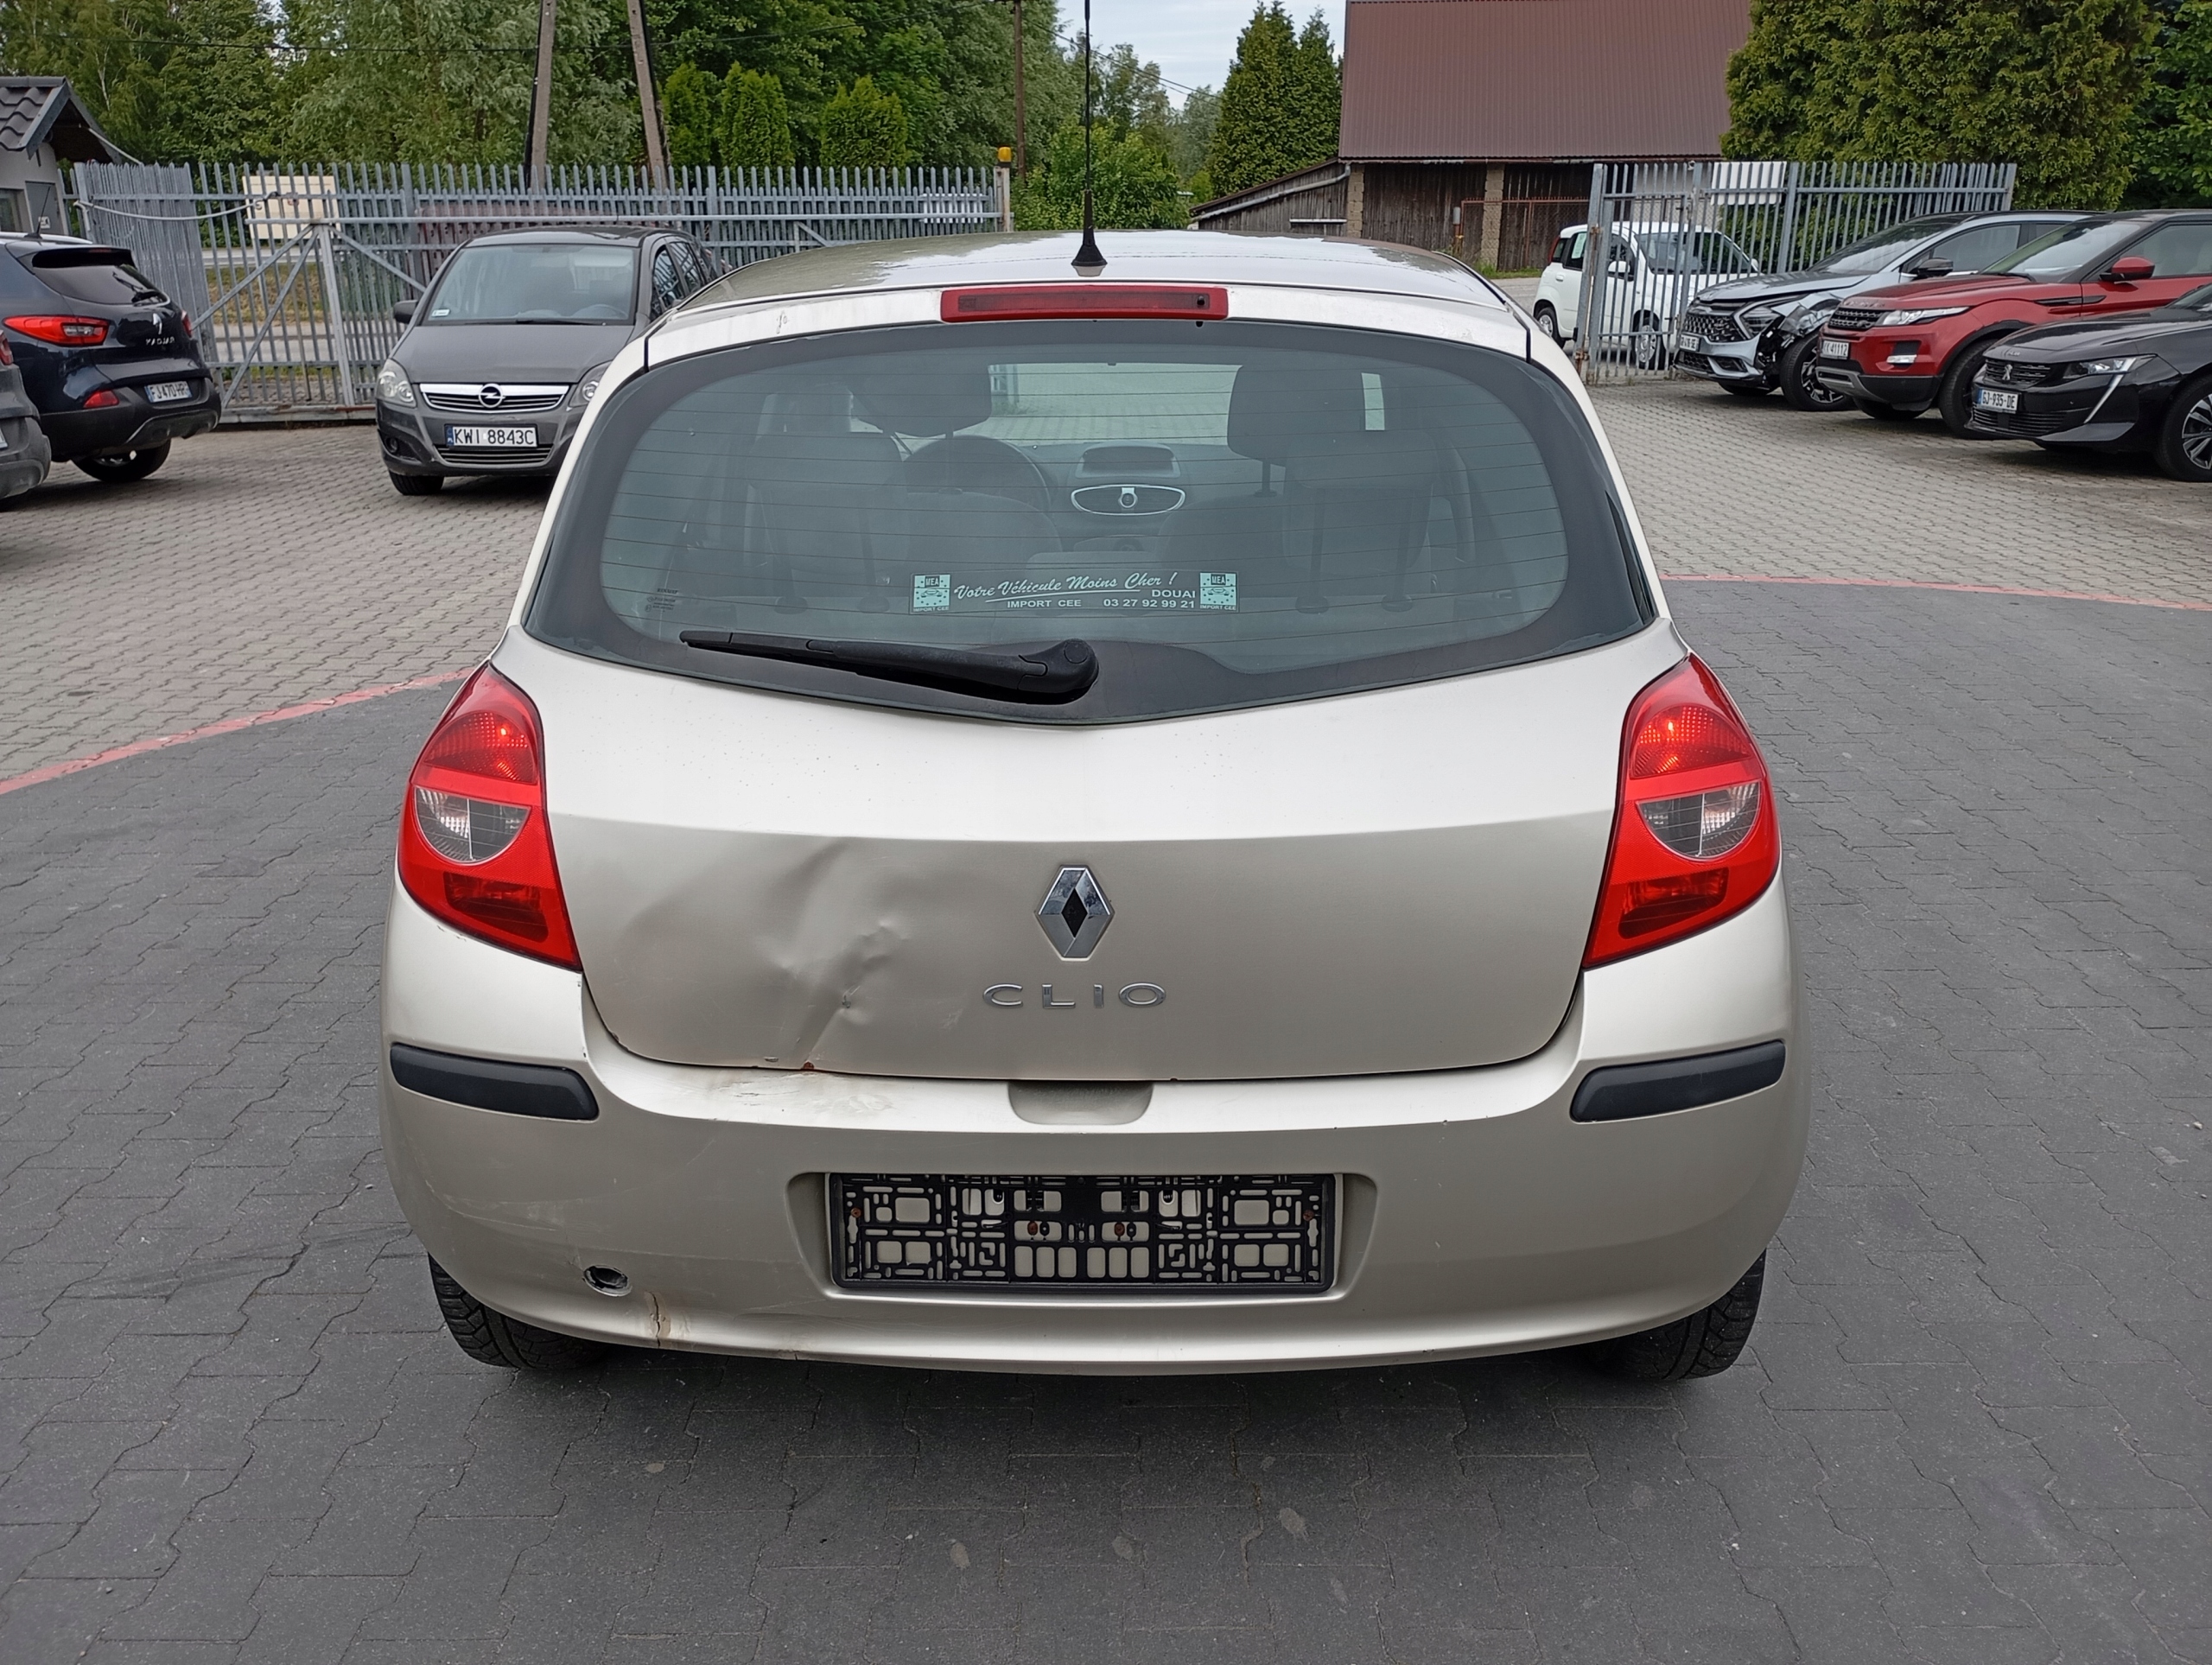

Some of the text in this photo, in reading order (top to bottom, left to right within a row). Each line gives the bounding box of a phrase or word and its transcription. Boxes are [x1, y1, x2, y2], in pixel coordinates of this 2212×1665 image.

[454, 429, 534, 445] KWI 8843C
[925, 577, 939, 587] MEA
[1211, 575, 1226, 585] MEA
[954, 584, 995, 600] Votre
[997, 578, 1062, 595] Véhicule
[1065, 575, 1118, 589] Moins
[1124, 572, 1162, 589] Cher
[1151, 589, 1196, 598] DOUAI
[1007, 599, 1082, 608] IMPORT CEE
[1103, 598, 1195, 608] 03 27 92 99 21
[982, 982, 1166, 1009] CLIO
